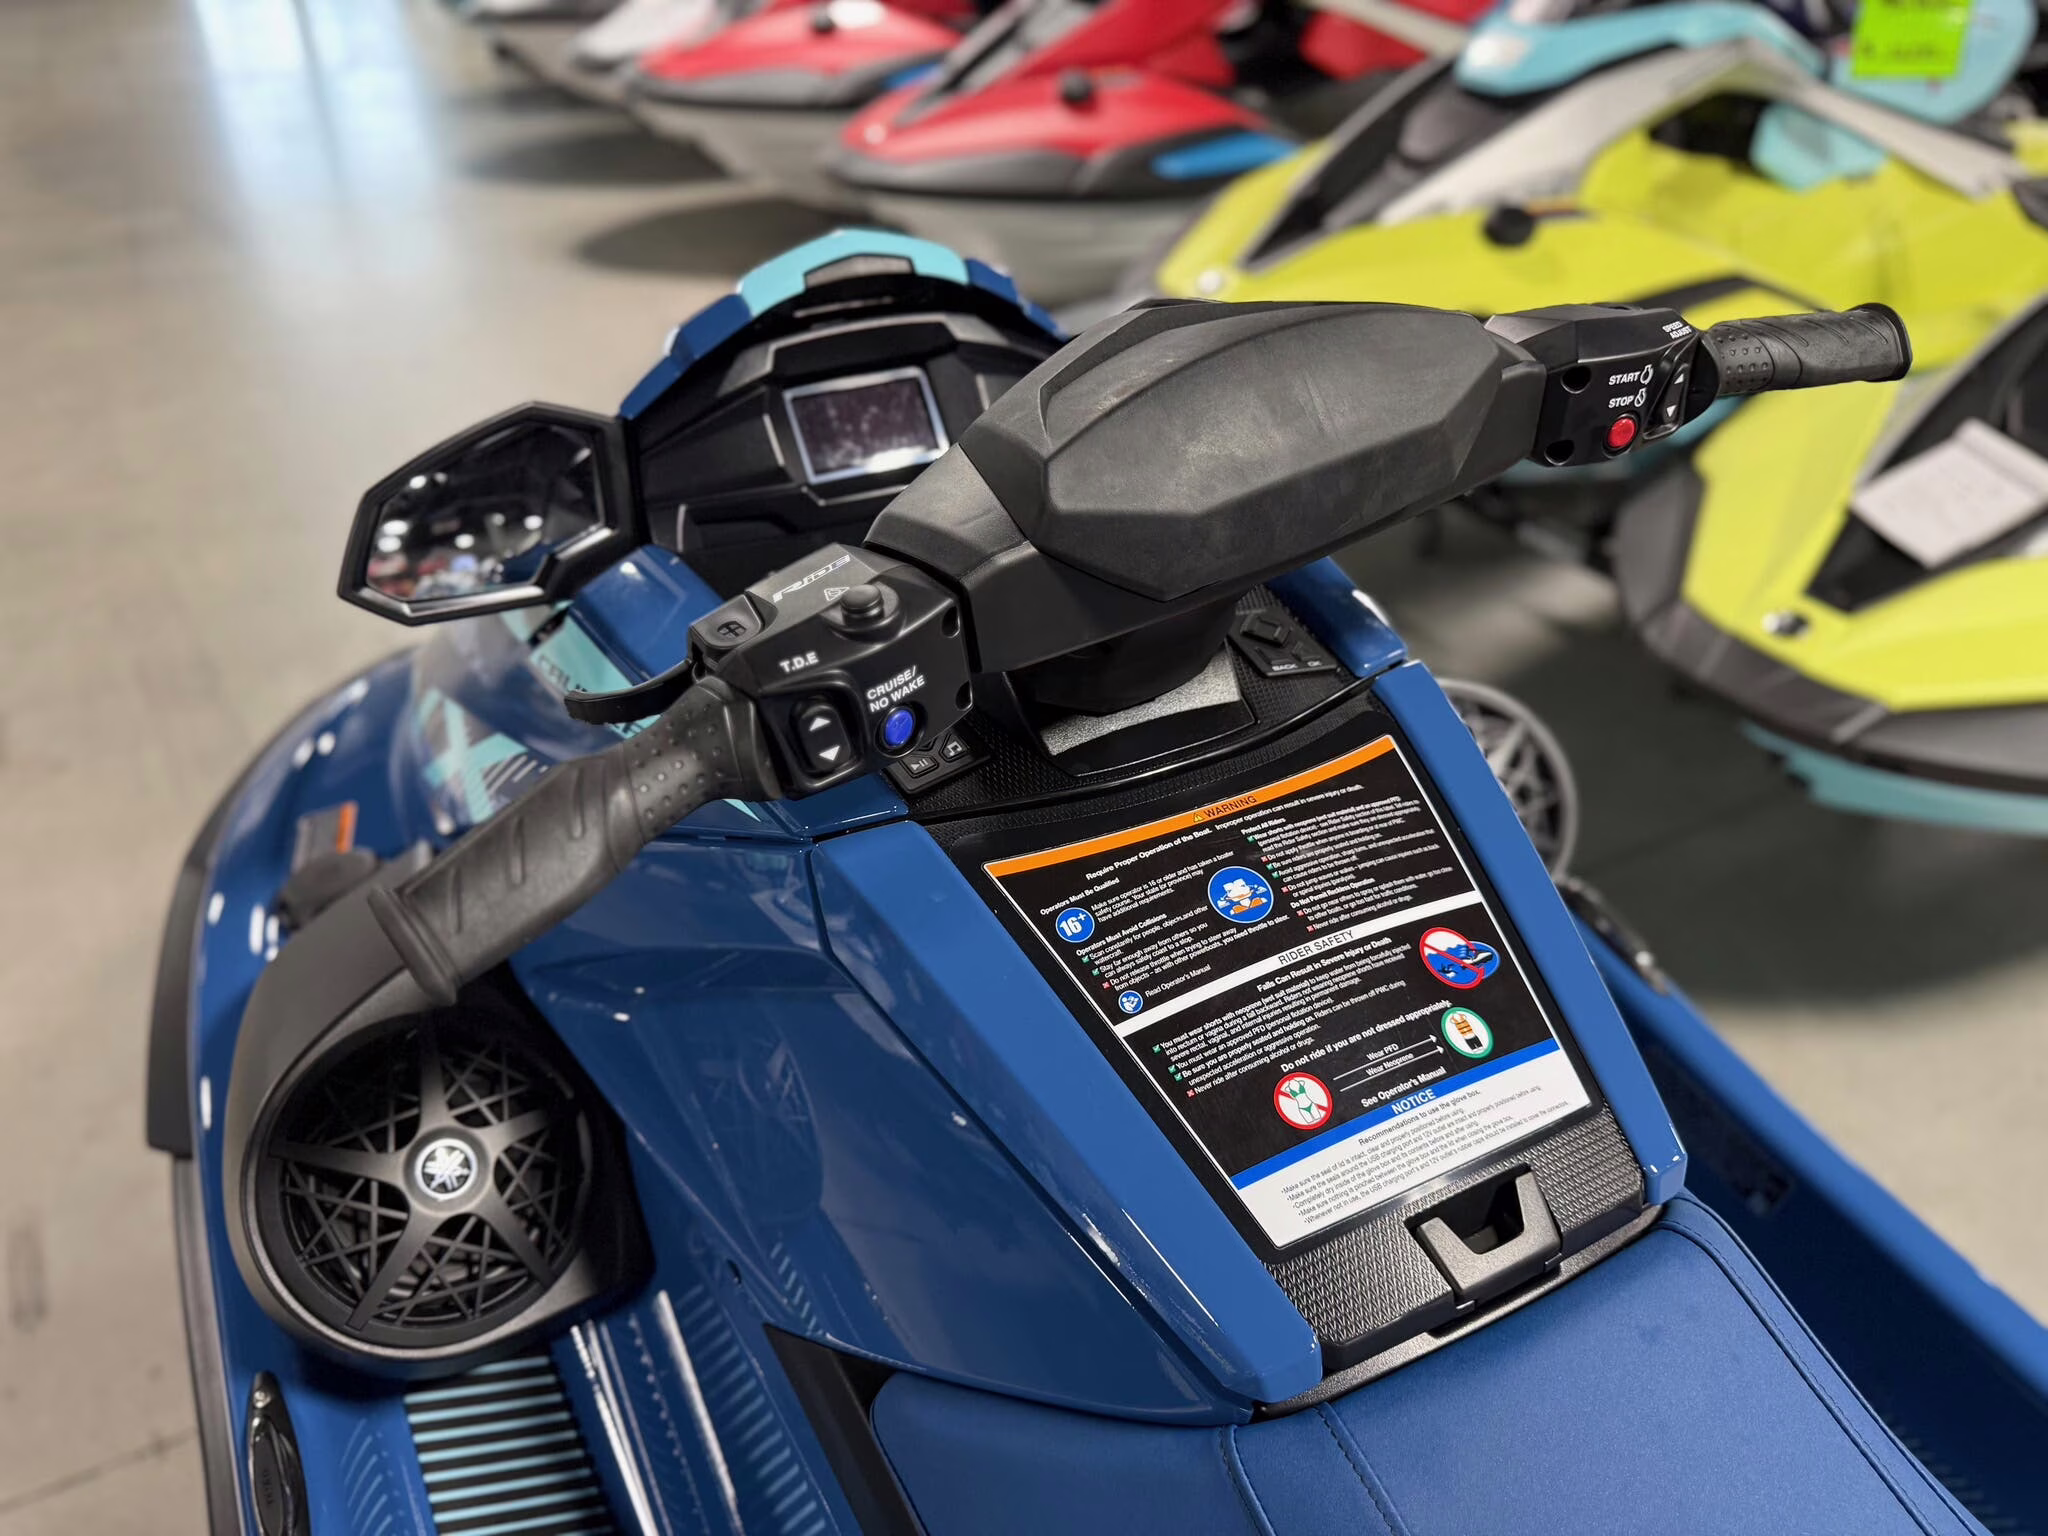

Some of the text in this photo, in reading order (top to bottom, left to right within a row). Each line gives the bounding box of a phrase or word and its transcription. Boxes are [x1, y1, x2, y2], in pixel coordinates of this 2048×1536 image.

[1662, 321, 1683, 332] SPEED
[1670, 325, 1692, 339] ADJUST
[1609, 371, 1641, 385] START
[1608, 395, 1635, 408] STOP
[780, 651, 818, 672] T.D.E
[867, 665, 916, 700] CRUISE/
[870, 675, 925, 713] NO WAKE
[1202, 794, 1258, 818] WARNING
[1085, 865, 1115, 881] Require
[1113, 855, 1139, 869] Proper
[1137, 842, 1174, 859] Operation
[1173, 837, 1182, 845] of
[1180, 834, 1194, 842] the
[1192, 827, 1212, 838] Boat.
[1039, 899, 1070, 915] Operators
[1068, 892, 1085, 902] Must
[1092, 876, 1120, 892] Qualified
[1075, 913, 1167, 956] Operators Must Avoid Collisions
[1277, 930, 1356, 964] RIDER SAFETY
[1144, 986, 1161, 997] Read
[1189, 964, 1211, 977] Manual
[1256, 981, 1276, 992] Falls
[1274, 975, 1291, 984] Can
[1289, 965, 1314, 978] Result
[1320, 954, 1345, 966] Severe
[1343, 947, 1365, 958] Injury
[1370, 936, 1392, 948] Death
[1280, 1062, 1295, 1072] Do
[1294, 1055, 1310, 1066] not
[1308, 1049, 1326, 1060] ride
[1324, 1044, 1333, 1053] if
[1332, 1040, 1349, 1052] you
[1347, 1034, 1362, 1043] are
[1361, 1027, 1376, 1038] not
[1374, 1015, 1406, 1032] dressed
[1366, 1043, 1399, 1060] Wear PFD
[1365, 1053, 1414, 1076] Wear Neoprene
[1359, 1065, 1447, 1107] See Operator's Manual
[1390, 1088, 1436, 1114] NOTICE
[1357, 1115, 1420, 1145] Recommendations
[1426, 1106, 1440, 1115] use
[1438, 1102, 1451, 1110] the
[1449, 1094, 1468, 1107] glove
